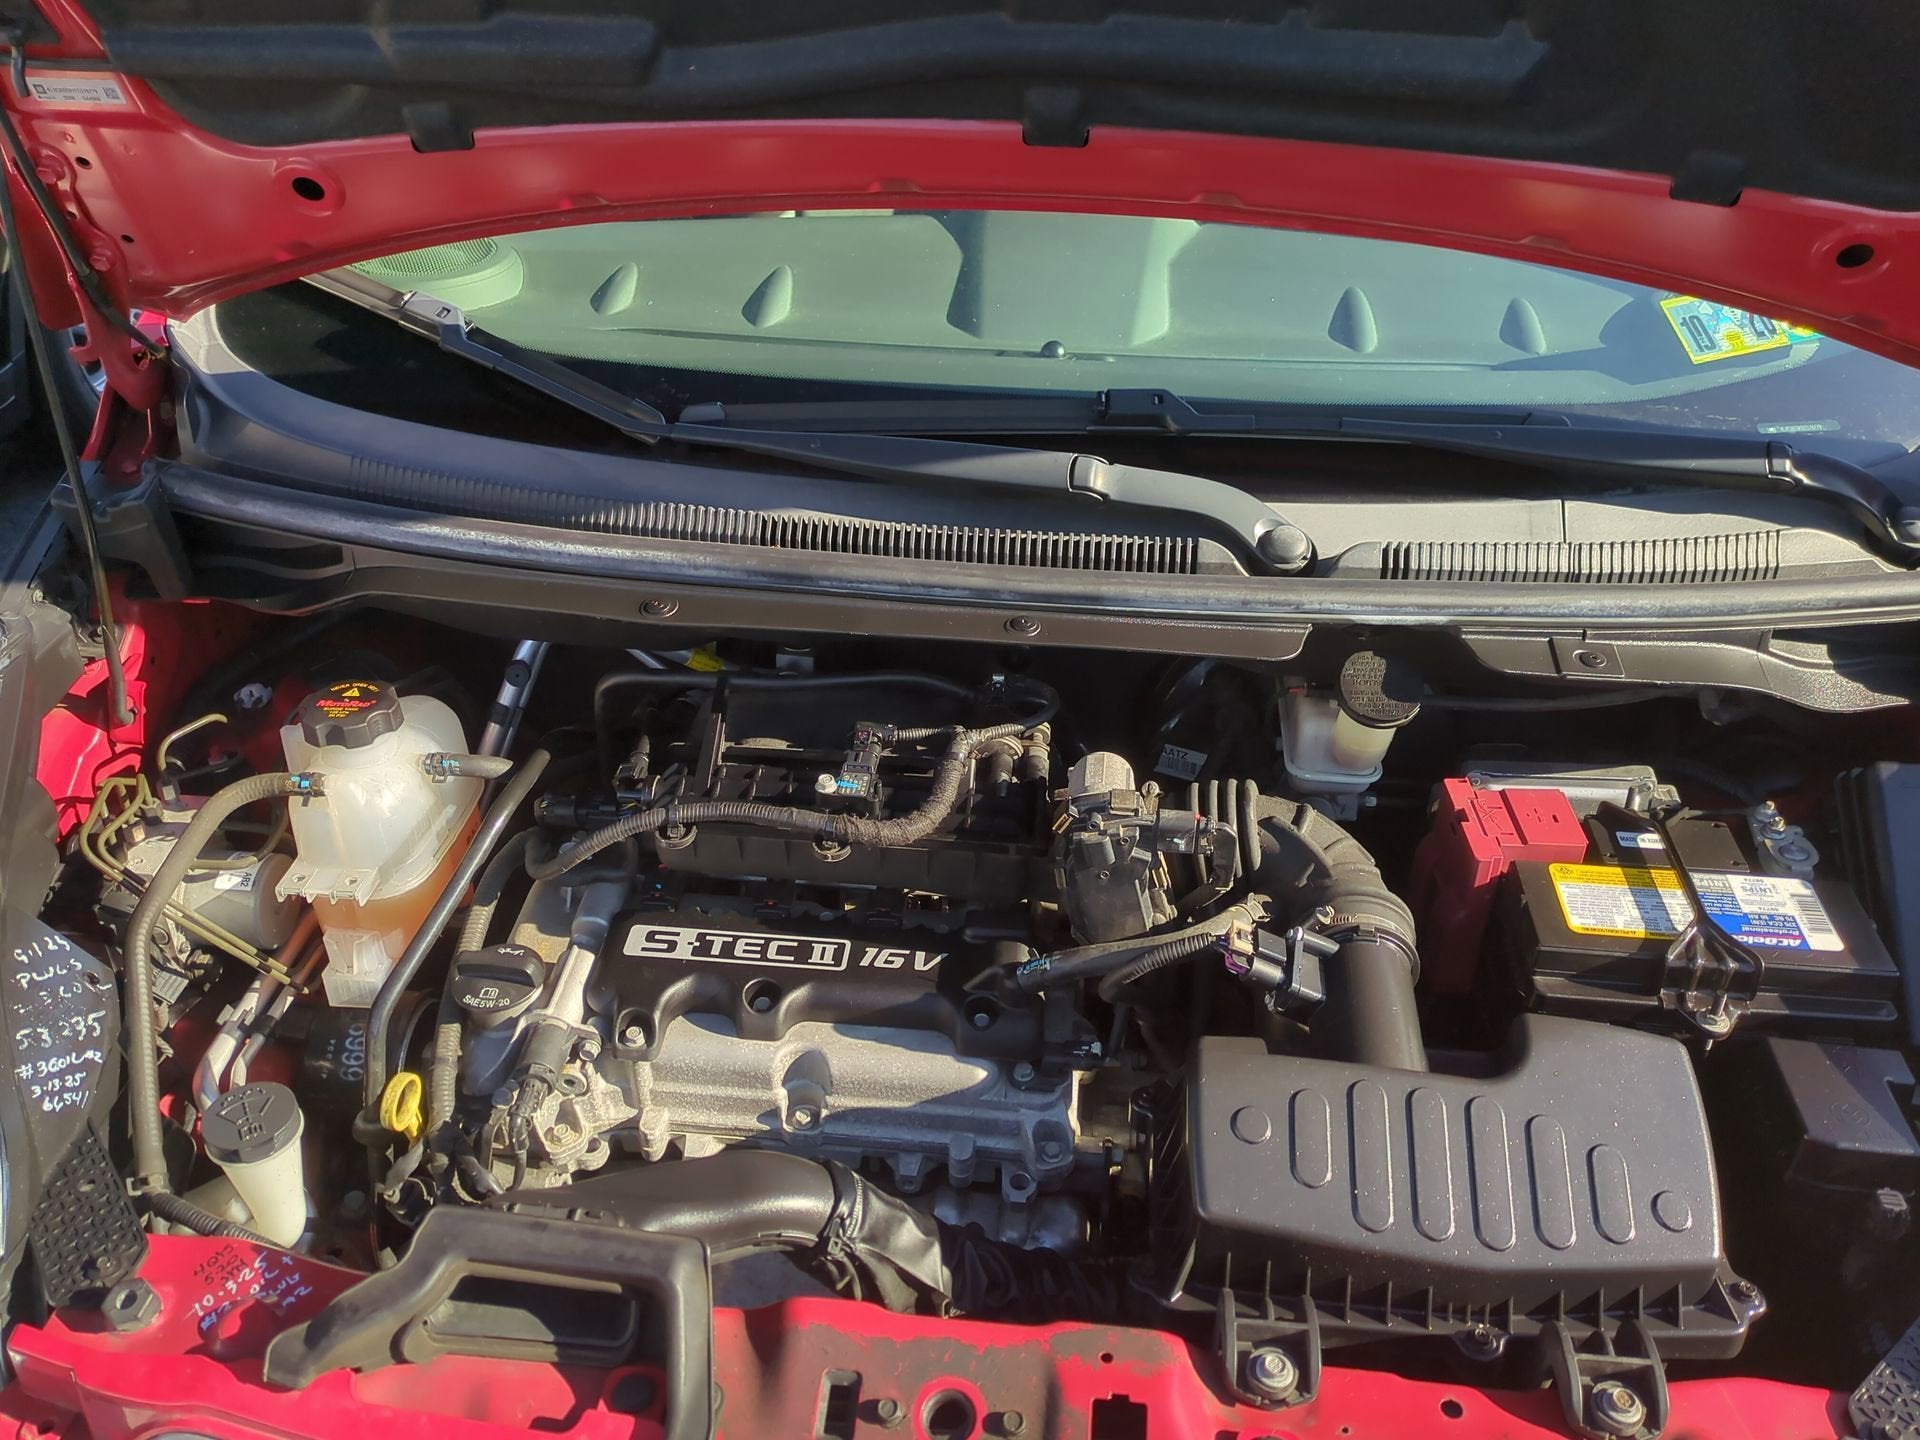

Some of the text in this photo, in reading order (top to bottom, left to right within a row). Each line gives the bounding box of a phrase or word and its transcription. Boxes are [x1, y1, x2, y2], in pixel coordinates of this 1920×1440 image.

[240, 872, 252, 888] AR2
[1742, 926, 1799, 936] Professional
[641, 930, 798, 961] S-TEC
[859, 948, 949, 971] 16V
